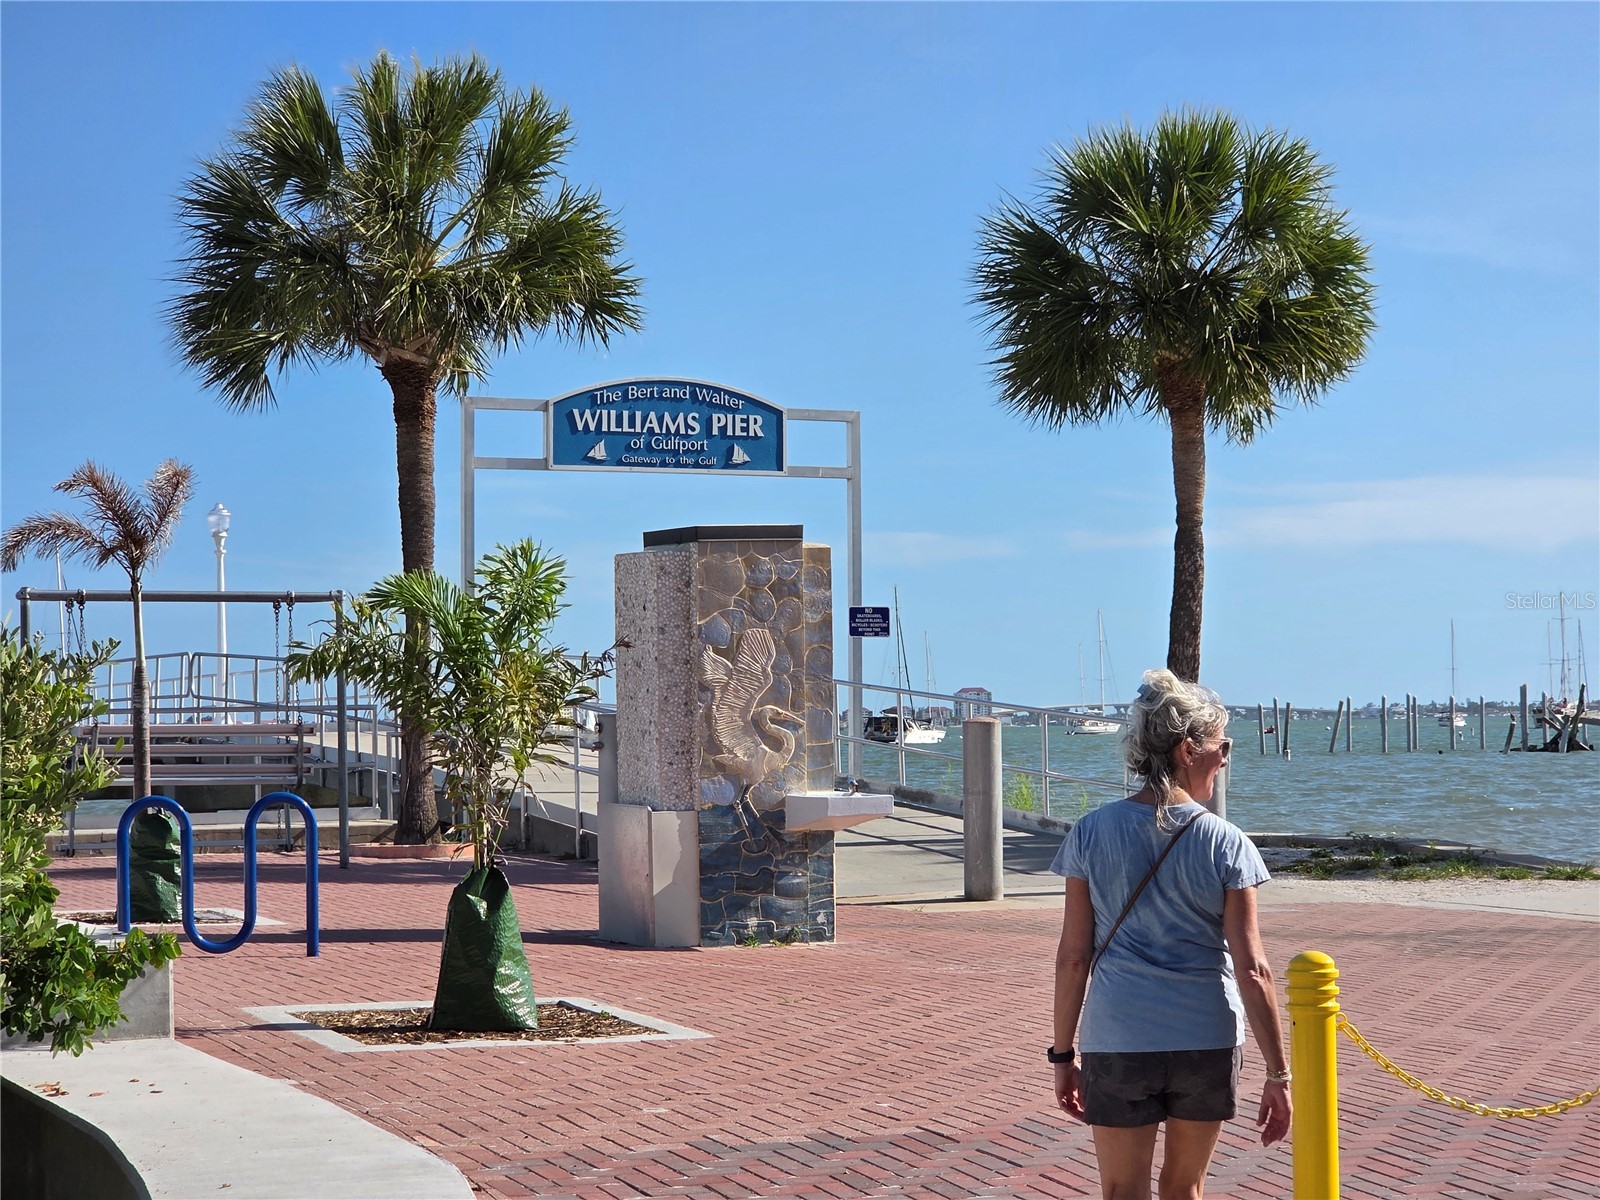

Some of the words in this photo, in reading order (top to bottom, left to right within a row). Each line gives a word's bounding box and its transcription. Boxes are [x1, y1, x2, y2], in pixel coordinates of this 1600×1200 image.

[594, 390, 622, 405] The
[628, 386, 658, 399] Bert
[662, 386, 689, 399] and
[696, 387, 744, 410] Walter
[572, 408, 700, 435] WILLIAMS
[712, 413, 764, 437] PIER
[630, 435, 645, 449] of
[651, 437, 709, 454] Gulfport
[621, 454, 661, 465] Gateway
[665, 456, 675, 464] to
[680, 456, 694, 465] the
[698, 456, 717, 465] Gulf
